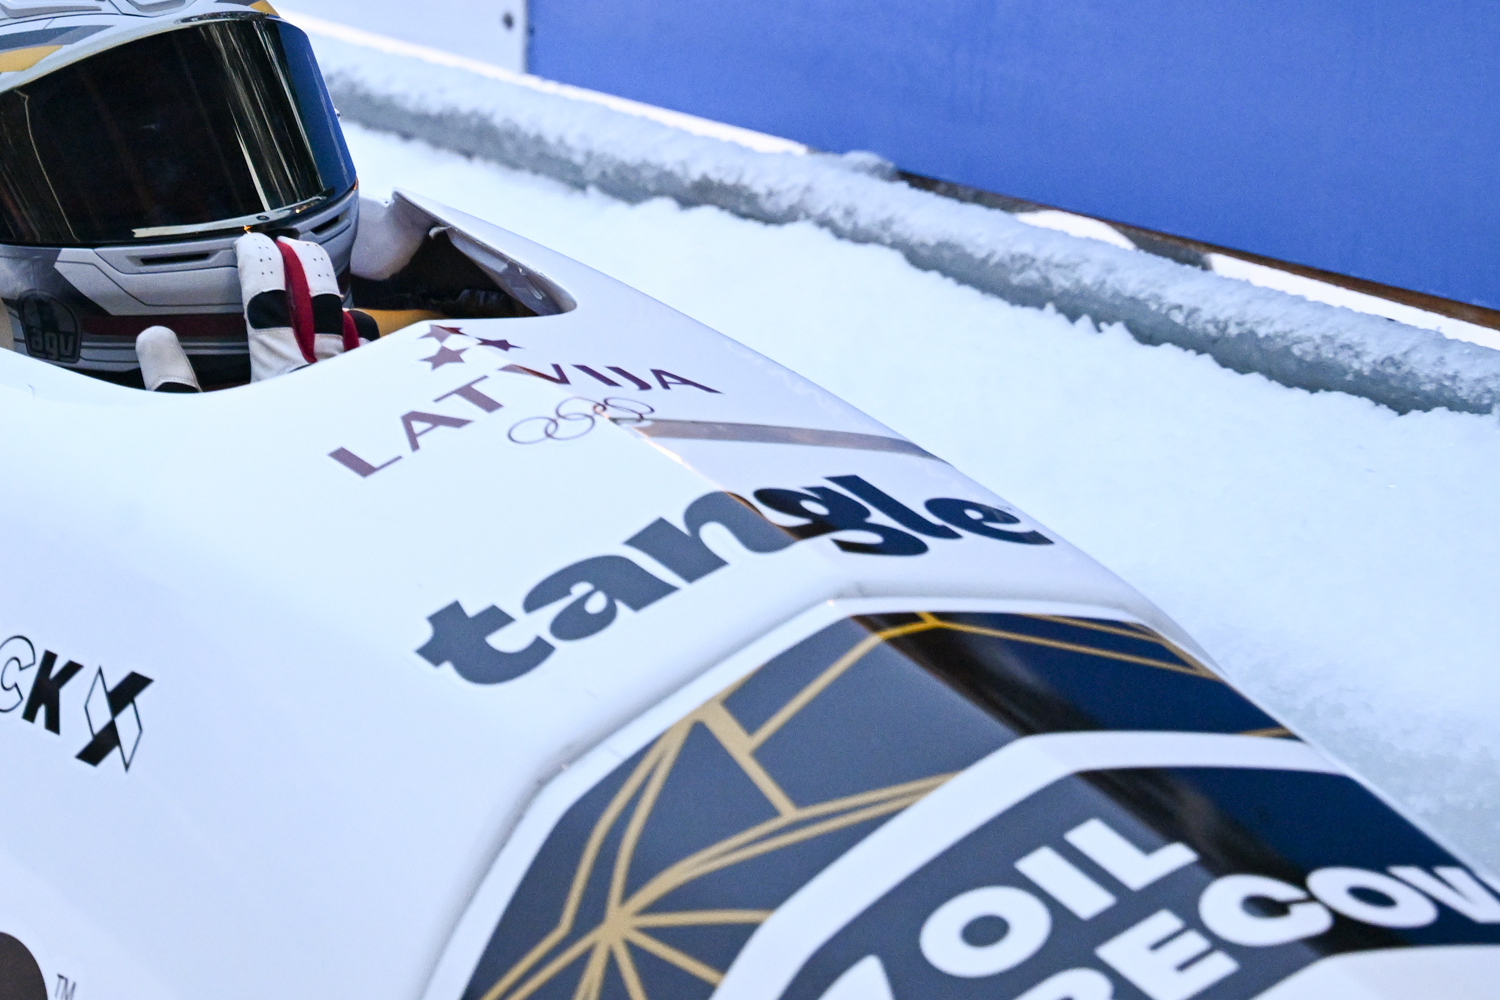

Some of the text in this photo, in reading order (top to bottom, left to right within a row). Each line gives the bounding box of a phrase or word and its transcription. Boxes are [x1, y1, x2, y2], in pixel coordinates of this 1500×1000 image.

[328, 362, 722, 478] LATVIJA
[414, 473, 1056, 687] tangle
[918, 817, 1199, 978] OIL
